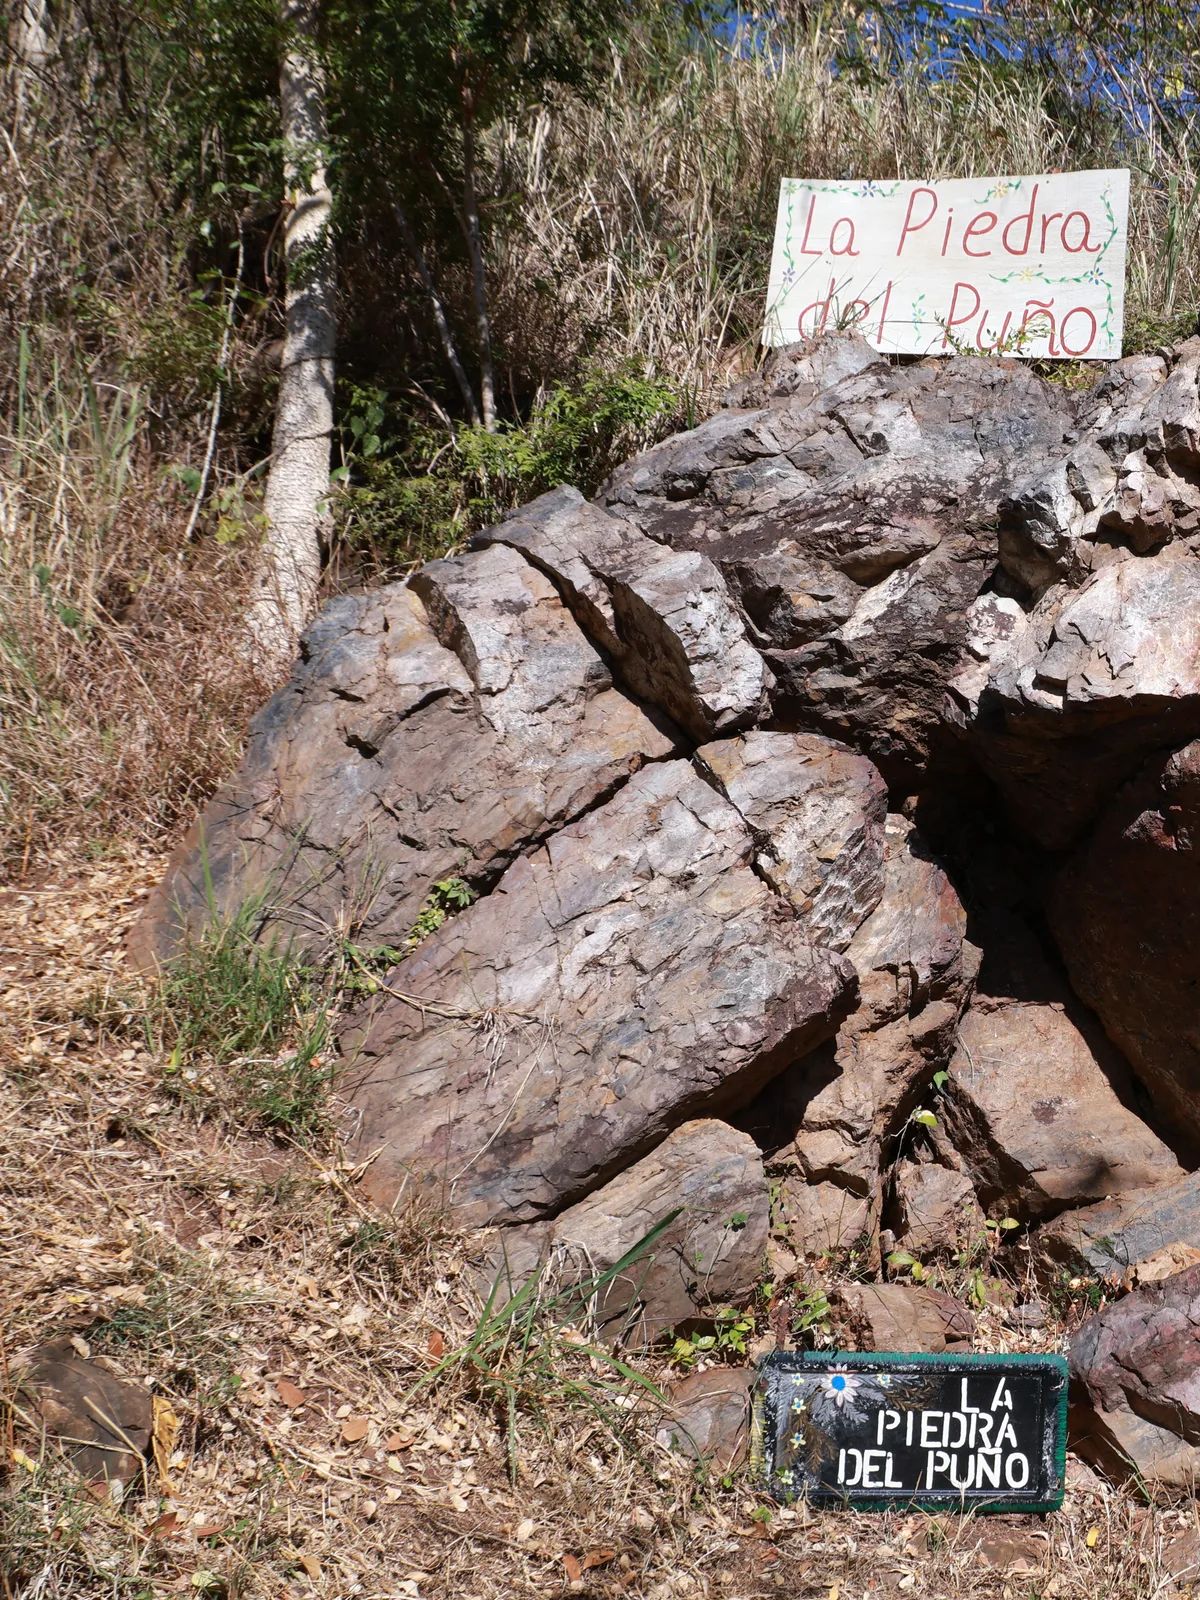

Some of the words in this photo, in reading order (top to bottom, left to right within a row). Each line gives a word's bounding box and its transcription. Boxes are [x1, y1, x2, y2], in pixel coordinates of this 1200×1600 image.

[800, 194, 860, 257] La
[897, 183, 1102, 257] Piedra
[942, 281, 1098, 356] Puño
[960, 1376, 1014, 1414] LA
[876, 1410, 1018, 1448] PIEDRA
[837, 1448, 903, 1489] DEL
[926, 1447, 1030, 1490] PUÑO
